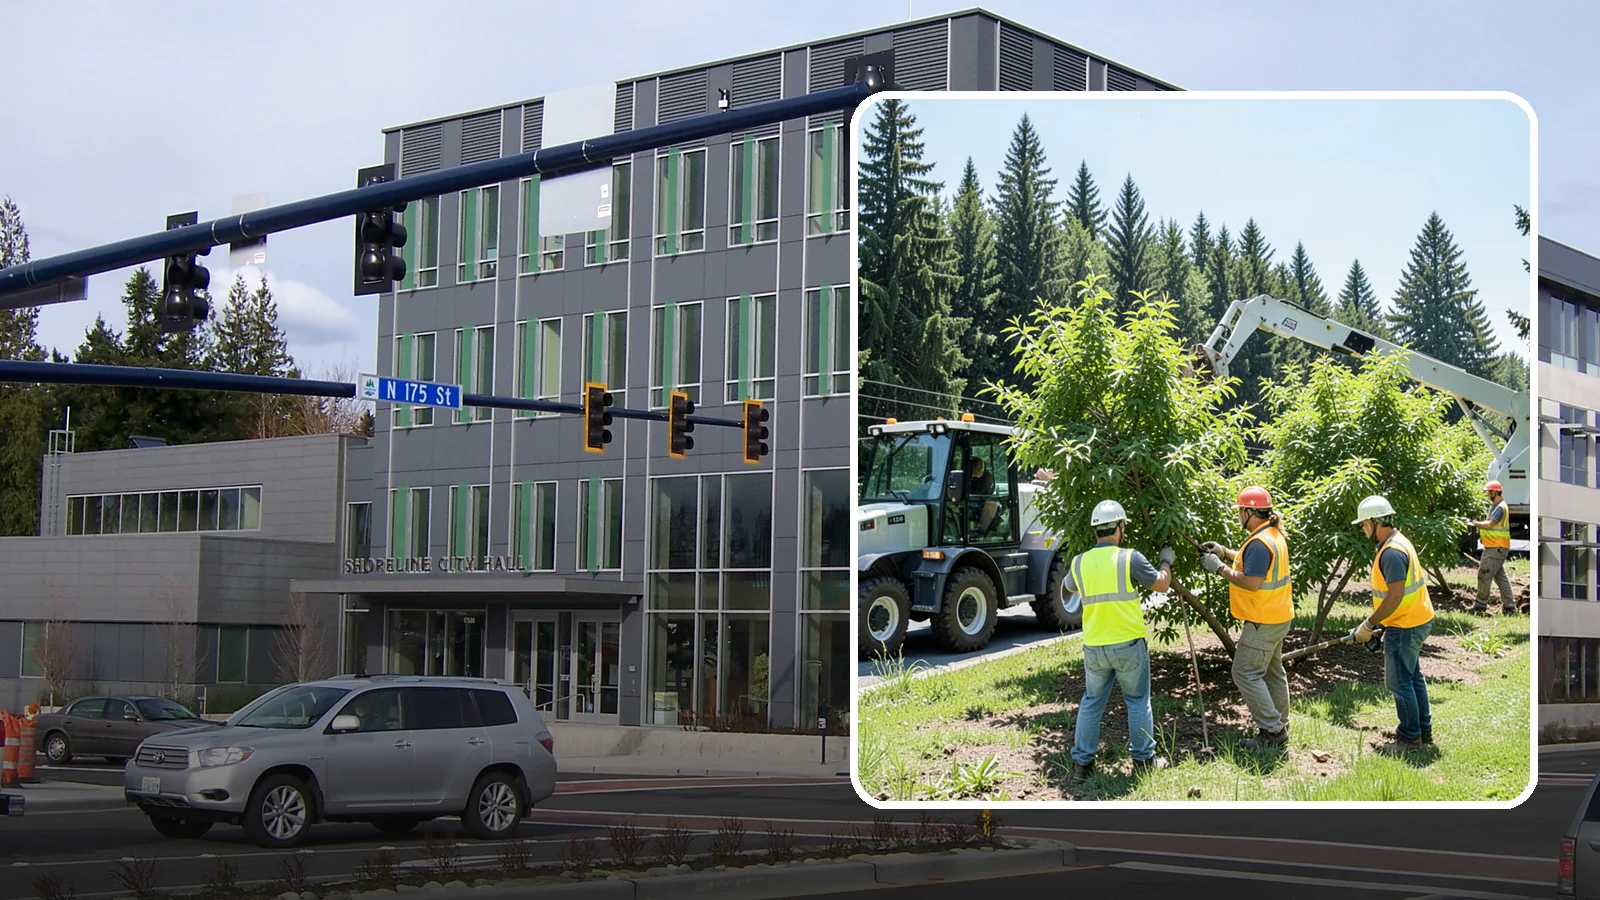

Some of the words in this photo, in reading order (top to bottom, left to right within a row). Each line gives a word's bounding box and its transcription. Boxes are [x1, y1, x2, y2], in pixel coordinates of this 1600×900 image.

[387, 380, 396, 400] N
[405, 382, 427, 403] 175
[436, 386, 451, 406] St
[344, 557, 432, 574] SHORELINE
[438, 556, 475, 572] CITY
[484, 555, 526, 572] HALL
